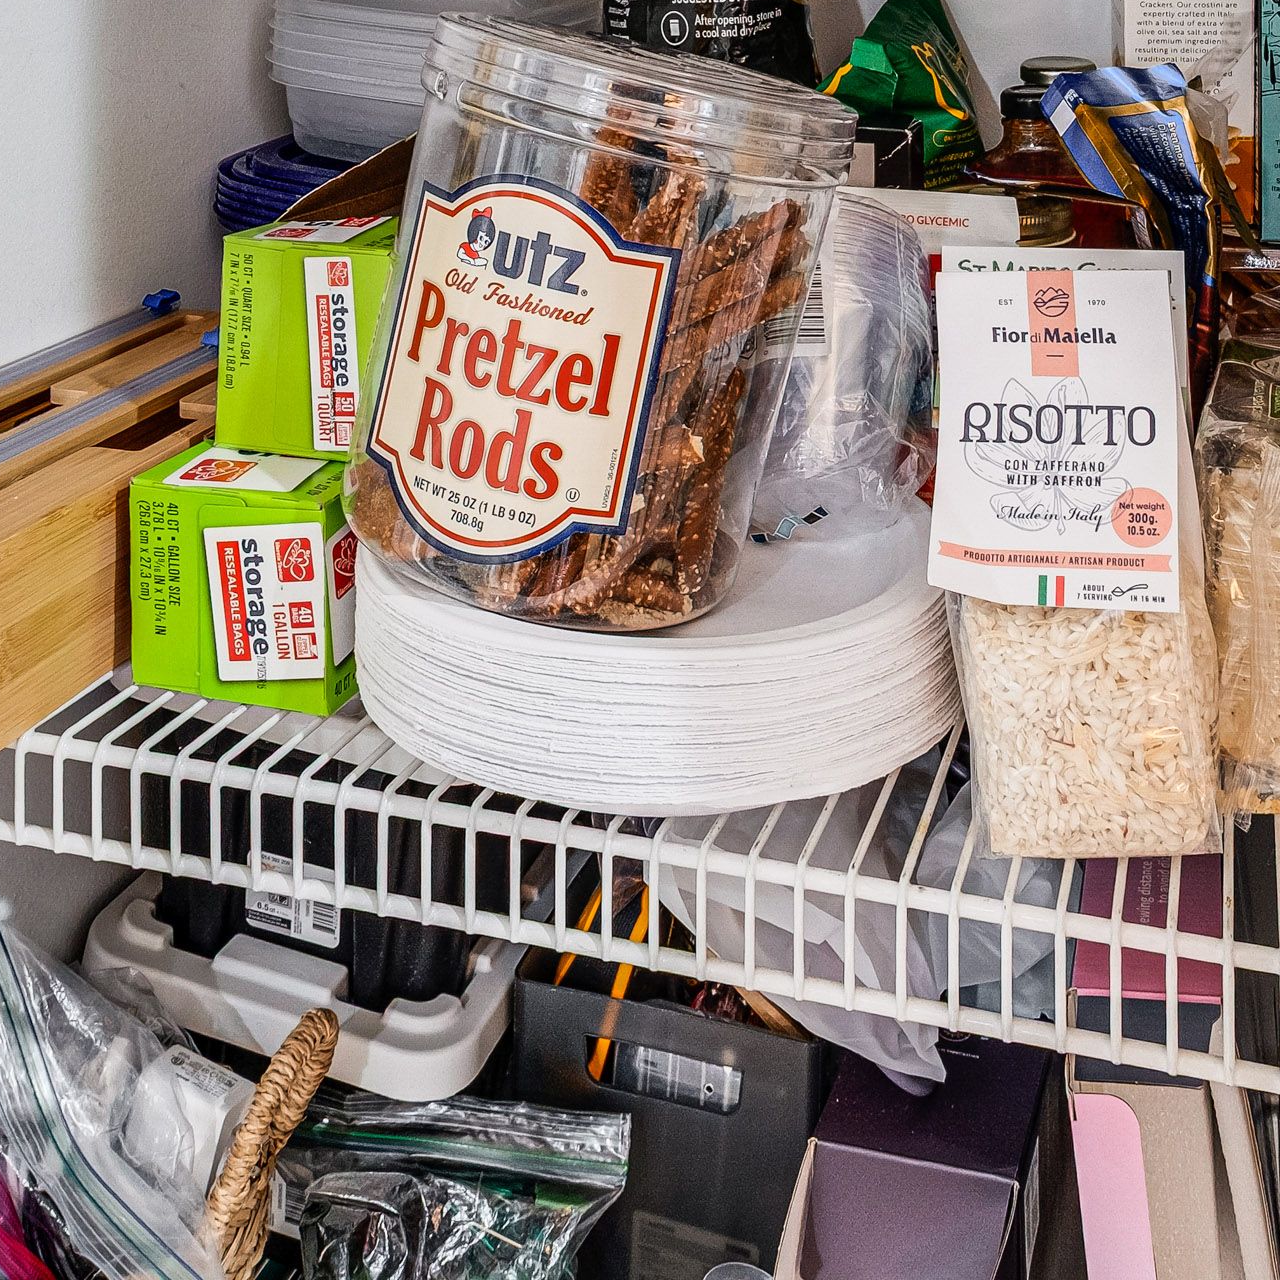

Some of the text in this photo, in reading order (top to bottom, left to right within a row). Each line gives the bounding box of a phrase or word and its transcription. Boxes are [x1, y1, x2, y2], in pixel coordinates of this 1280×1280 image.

[694, 14, 715, 25] After
[756, 10, 773, 21] store
[775, 8, 781, 17] in
[701, 27, 719, 38] cool
[721, 26, 738, 37] and
[740, 24, 752, 39] dry
[753, 22, 771, 35] place
[916, 215, 970, 229] GLYCEMIC
[493, 229, 586, 295] utz
[445, 267, 595, 327] Old Fashioned
[998, 298, 1106, 307] EST 1970
[318, 298, 332, 387] RESEALABLE BAGS
[331, 293, 349, 387] storage
[991, 326, 1117, 345] Fior di Maiella
[407, 279, 622, 418] Pretzel
[959, 401, 1156, 448] RISOTTO
[409, 376, 564, 502] Rods
[1004, 459, 1105, 473] CON ZAFFERANO
[1006, 473, 1103, 487] WITH SAFFRON
[996, 503, 1104, 532] Made in Italy
[1118, 502, 1165, 513] Net weight
[450, 510, 485, 532] 708.8g
[1127, 526, 1160, 537] 10.5 oz.
[963, 550, 1146, 568] PRODOTTO ARTIGIANALE ARTISAN PRODUCT
[223, 547, 245, 655] RESEALABLE BAGS
[241, 538, 269, 654] storage
[274, 612, 291, 660] GALLON
